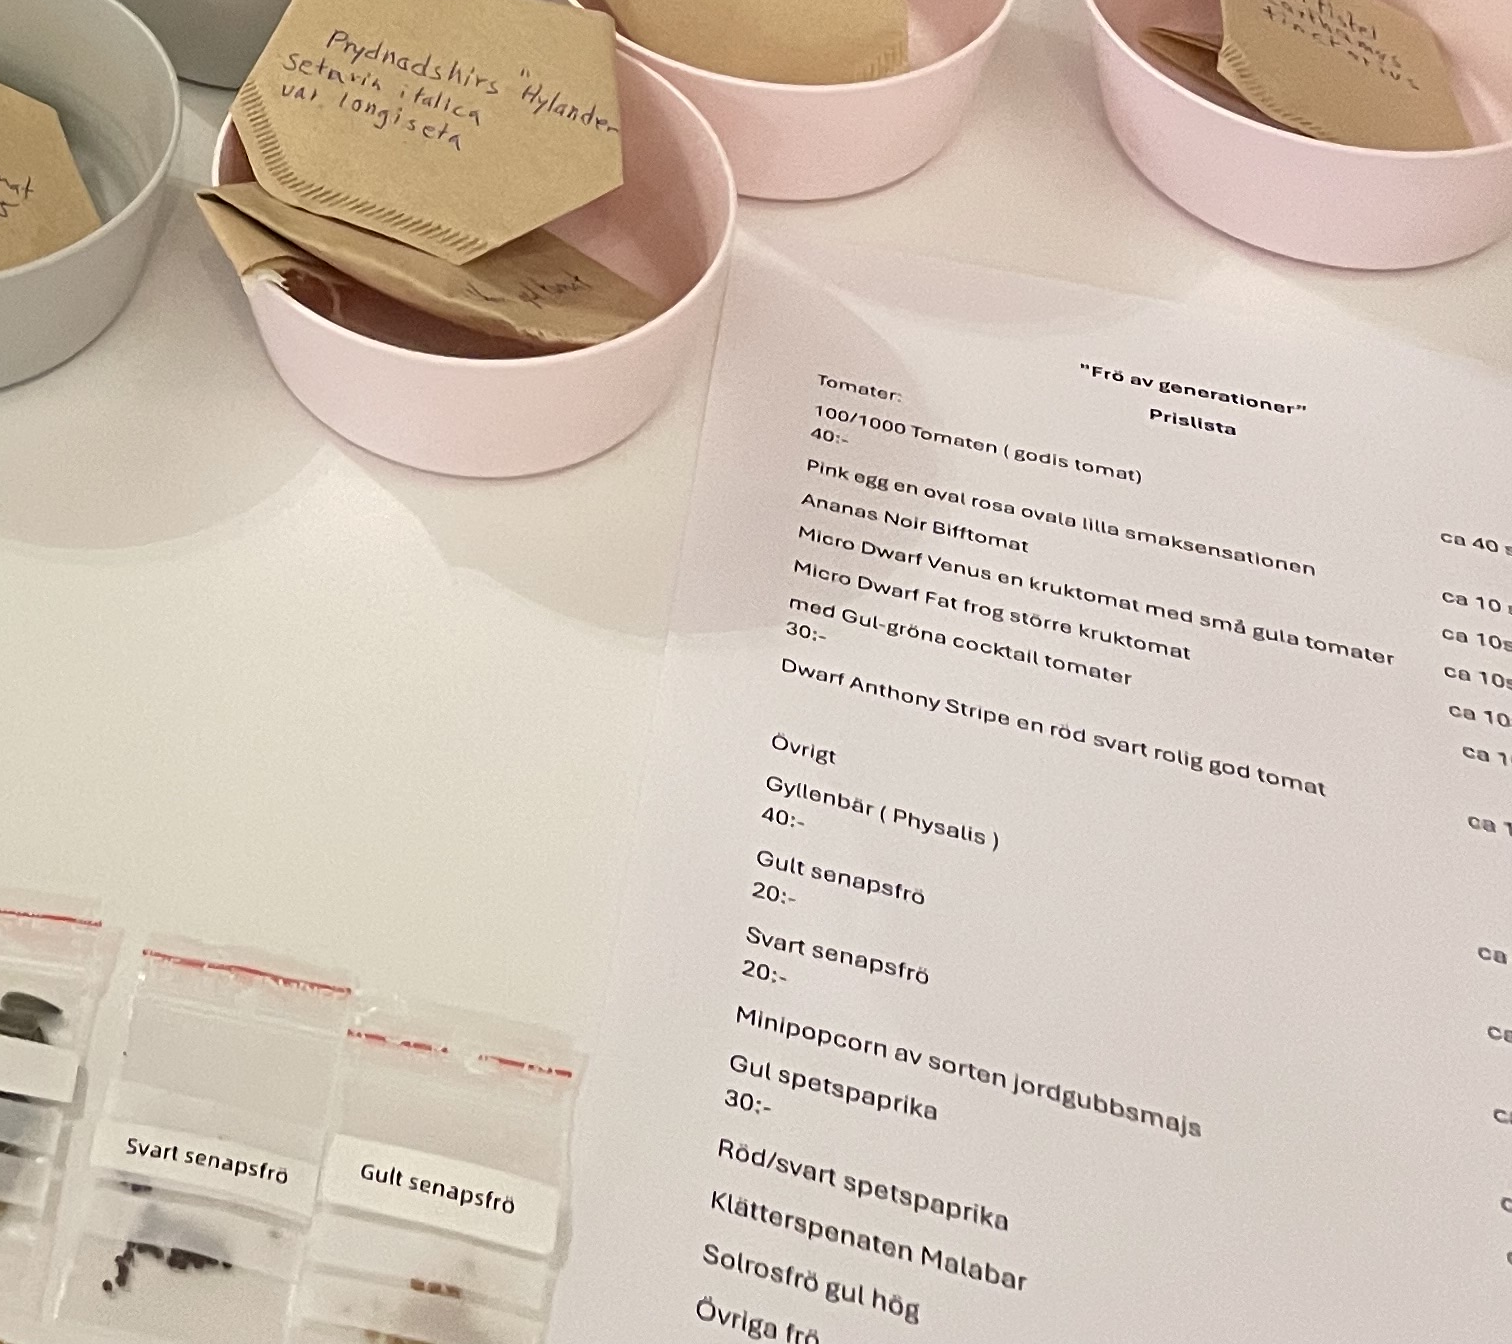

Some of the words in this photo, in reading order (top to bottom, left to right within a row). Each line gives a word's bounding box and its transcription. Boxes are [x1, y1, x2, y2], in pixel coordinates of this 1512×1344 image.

[338, 92, 462, 152] longiseta
[399, 82, 482, 127] italica
[817, 373, 902, 403] Tomater:
[1130, 375, 1154, 388] av
[815, 405, 907, 435] 100/1000
[910, 424, 998, 454] Tomaten
[1013, 448, 1069, 468] godis
[1074, 459, 1142, 486] tomat)
[1149, 408, 1237, 436] Prislista
[800, 493, 878, 521] Ananas
[883, 510, 928, 532] Noir
[932, 520, 1029, 554] Bifftomat
[806, 458, 850, 481] Pink
[854, 472, 889, 492] egg
[893, 481, 918, 496] en
[923, 487, 966, 506] oval
[971, 496, 1015, 515] rosa
[1021, 507, 1077, 528] ovala
[1082, 517, 1119, 537] lilla
[1125, 528, 1316, 577] smaksensationen
[1440, 532, 1467, 547] ca
[1472, 537, 1499, 553] 40
[793, 558, 851, 586] Micro
[857, 575, 920, 602] Dwarf
[925, 590, 958, 611] Fat
[963, 598, 1005, 623] frog
[1009, 611, 1072, 635] större
[1078, 623, 1191, 661] kruktomat
[798, 525, 855, 551] Micro
[860, 540, 924, 566] Dwarf
[927, 554, 992, 581] Venus
[997, 572, 1023, 588] en
[1029, 576, 1140, 613] kruktomat
[1145, 603, 1193, 624] med
[1199, 615, 1247, 635] små
[1252, 626, 1299, 646] gula
[1304, 635, 1395, 666] tomater
[1441, 591, 1469, 606] ca
[1475, 595, 1502, 613] 10
[789, 597, 836, 619] med
[841, 608, 947, 646] Gul-gröna
[952, 636, 1039, 666] cocktail
[1044, 654, 1133, 686] tomater
[1441, 627, 1469, 644] ca
[1444, 666, 1471, 682] ca
[781, 657, 845, 686] Dwarf
[848, 676, 941, 712] Anthony
[944, 698, 1010, 726] Stripe
[1016, 717, 1044, 734] en
[1050, 723, 1086, 744] röd
[1093, 734, 1148, 758] svart
[1154, 747, 1204, 773] rolig
[1208, 759, 1250, 779] god
[1256, 767, 1327, 798] tomat
[1448, 705, 1476, 721] ca
[771, 731, 837, 766] Övrigt
[1462, 745, 1490, 762] ca
[766, 775, 875, 817] Gyllenbär
[893, 807, 986, 846] Physalis
[1467, 815, 1497, 834] ca
[756, 850, 806, 877] Gult
[810, 866, 925, 905] senapsfrö
[745, 926, 806, 957] Svart
[811, 944, 929, 985] senapsfrö
[1477, 946, 1508, 965] ca
[729, 1054, 771, 1081] Gul
[778, 1069, 938, 1121] spetspaprika
[736, 1005, 887, 1059] Minipopcorn
[894, 1047, 923, 1066] av
[928, 1055, 1007, 1089] sorten
[1011, 1072, 1202, 1139] jordgubbsmajs
[125, 1137, 180, 1162] Svart
[185, 1148, 289, 1186] senapsfrö
[717, 1137, 837, 1188] Röd/svart
[843, 1175, 1009, 1232] spetspaprika
[359, 1162, 404, 1188] Gult
[408, 1172, 517, 1216] senapsfrö
[711, 1190, 913, 1263] Klätterspenaten
[921, 1245, 1028, 1292] Malabar
[702, 1243, 819, 1293] Solrosfrö
[824, 1281, 865, 1306] gul
[872, 1287, 920, 1326] hög
[696, 1295, 778, 1341] Övriga
